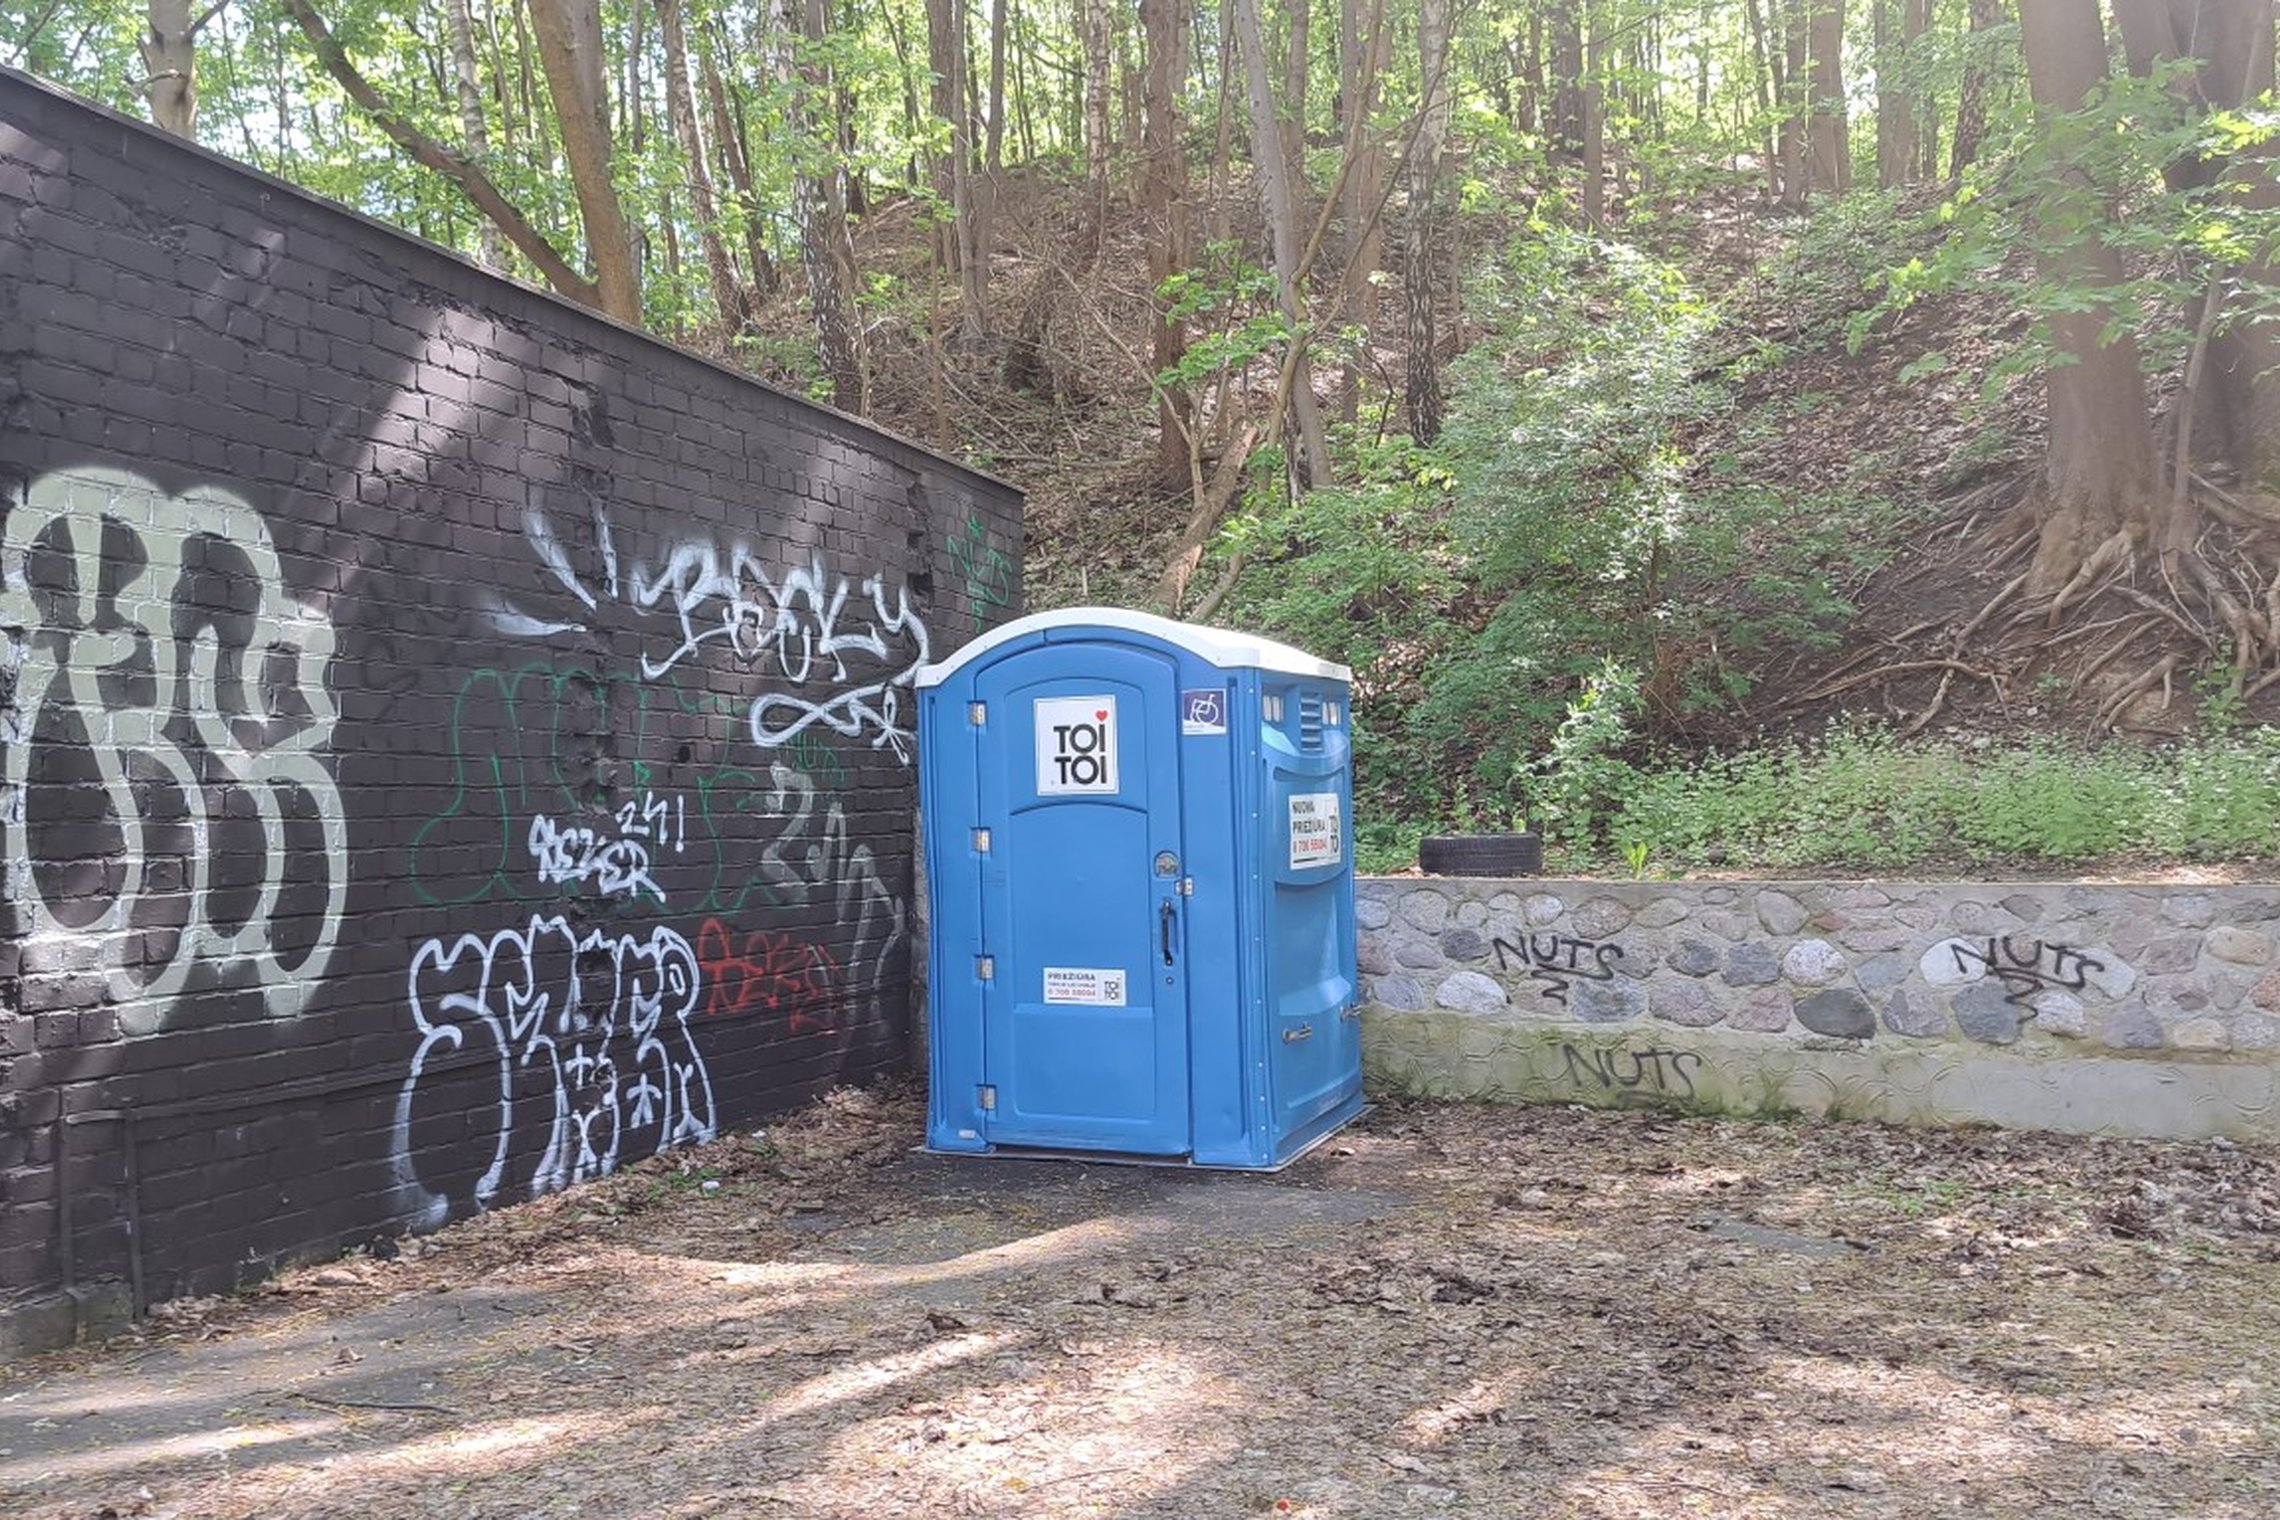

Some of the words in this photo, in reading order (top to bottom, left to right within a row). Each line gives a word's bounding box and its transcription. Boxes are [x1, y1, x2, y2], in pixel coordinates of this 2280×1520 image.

[1053, 712, 1108, 754] TOI
[1054, 755, 1107, 785] TOI
[1492, 934, 1625, 981] NUTS
[1951, 936, 2105, 989] NUTS
[1562, 1043, 1702, 1099] NUTS
